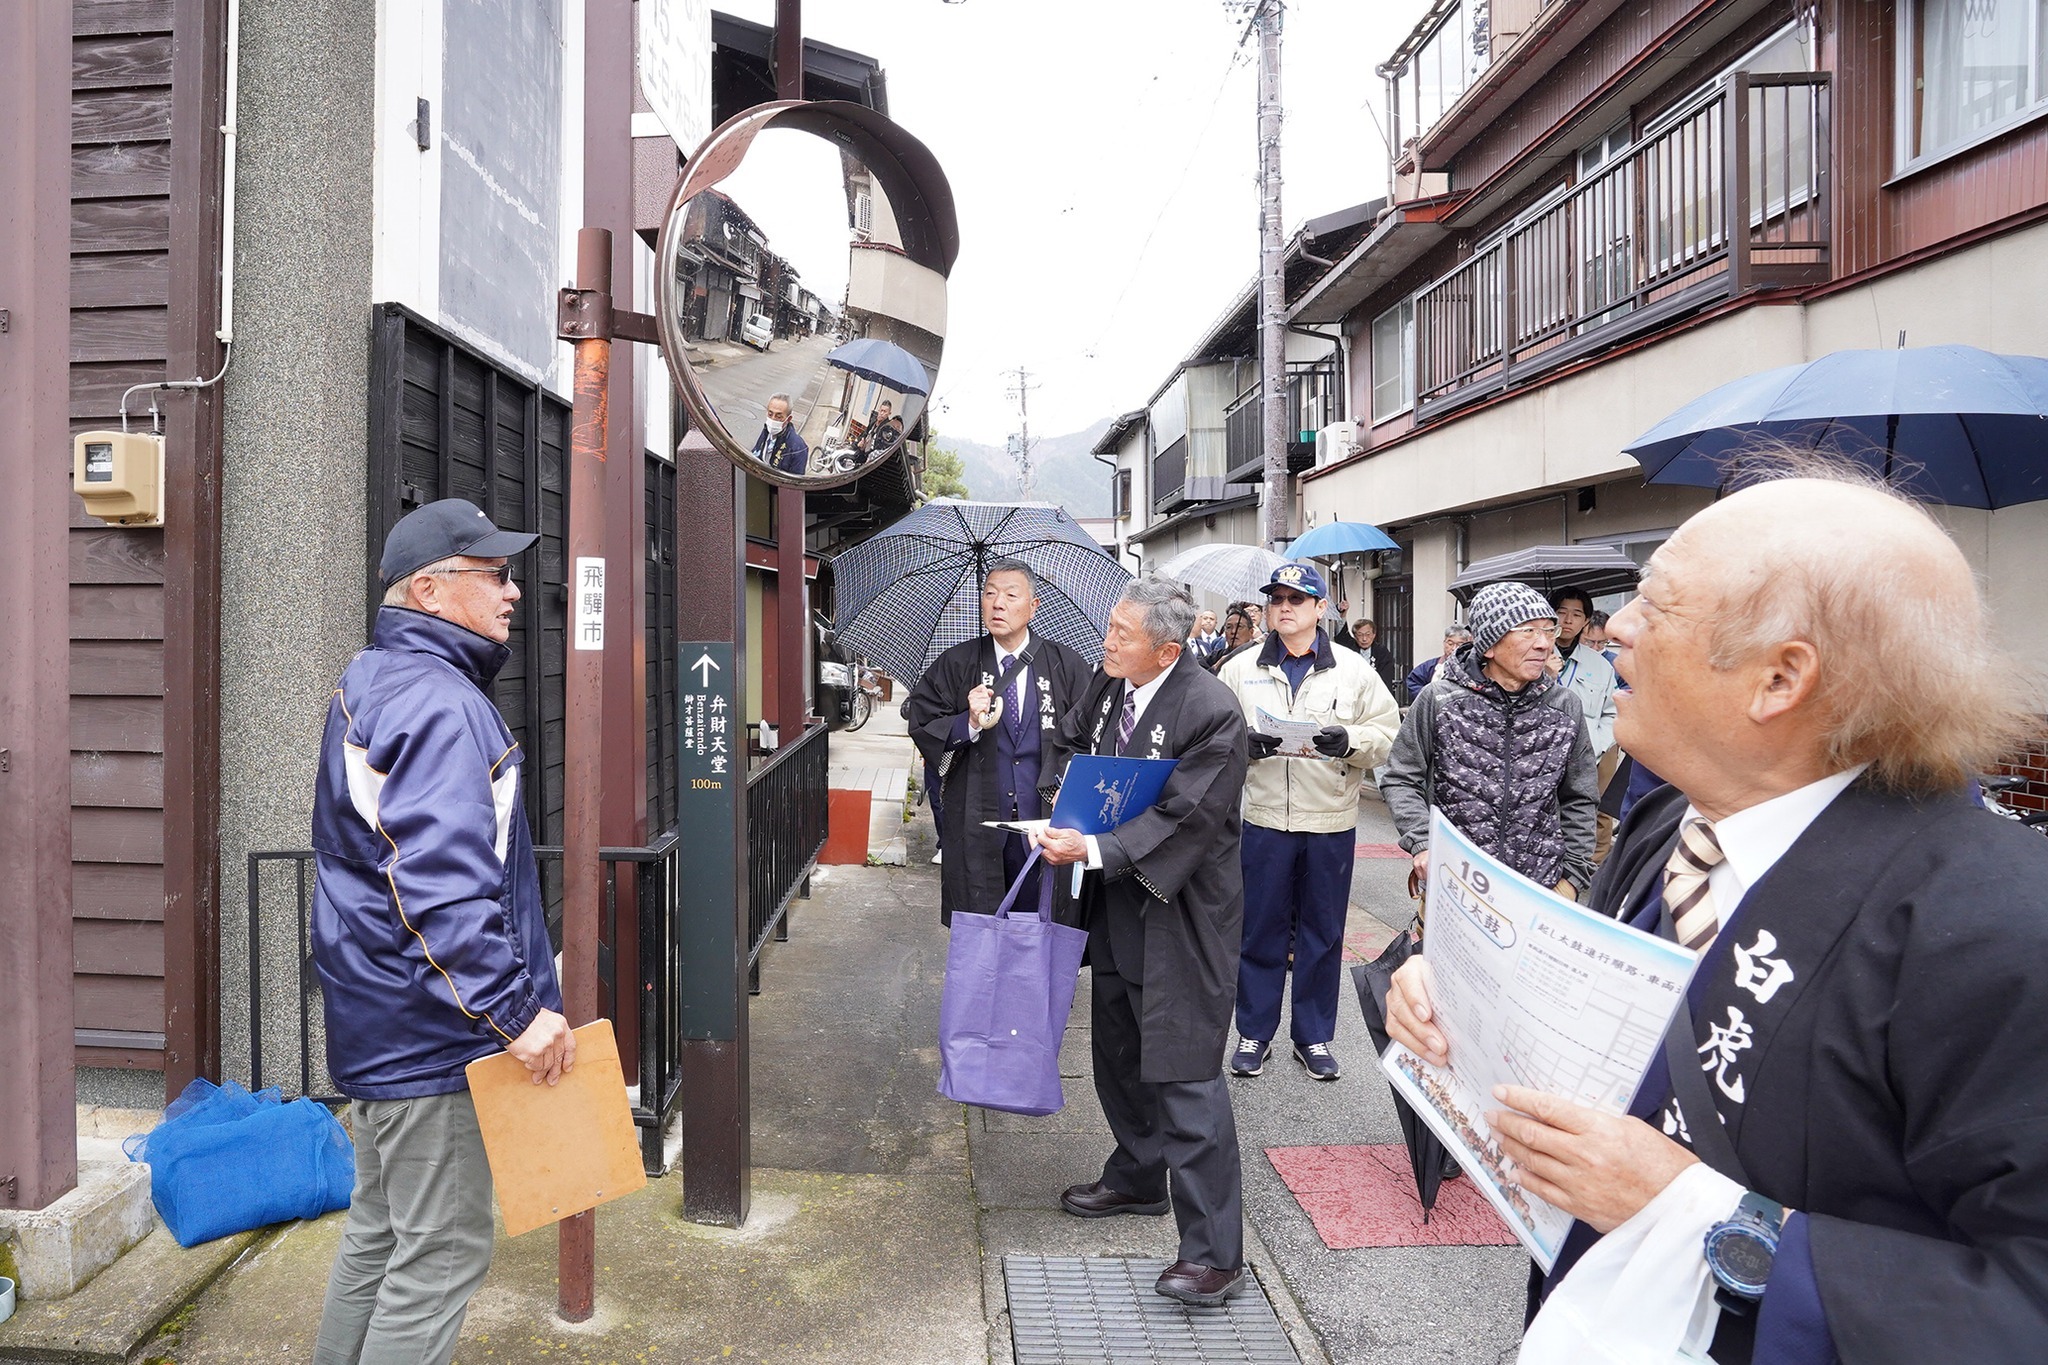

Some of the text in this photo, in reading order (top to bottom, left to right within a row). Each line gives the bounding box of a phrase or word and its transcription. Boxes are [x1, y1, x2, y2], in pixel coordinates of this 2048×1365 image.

[696, 694, 708, 756] Benzaitendo
[709, 694, 728, 774] 弁財天堂
[1036, 676, 1056, 730] 白虎組
[690, 778, 722, 790] 100m
[1447, 877, 1501, 939] 起し太鼓
[1663, 928, 1795, 1143] 白虎
